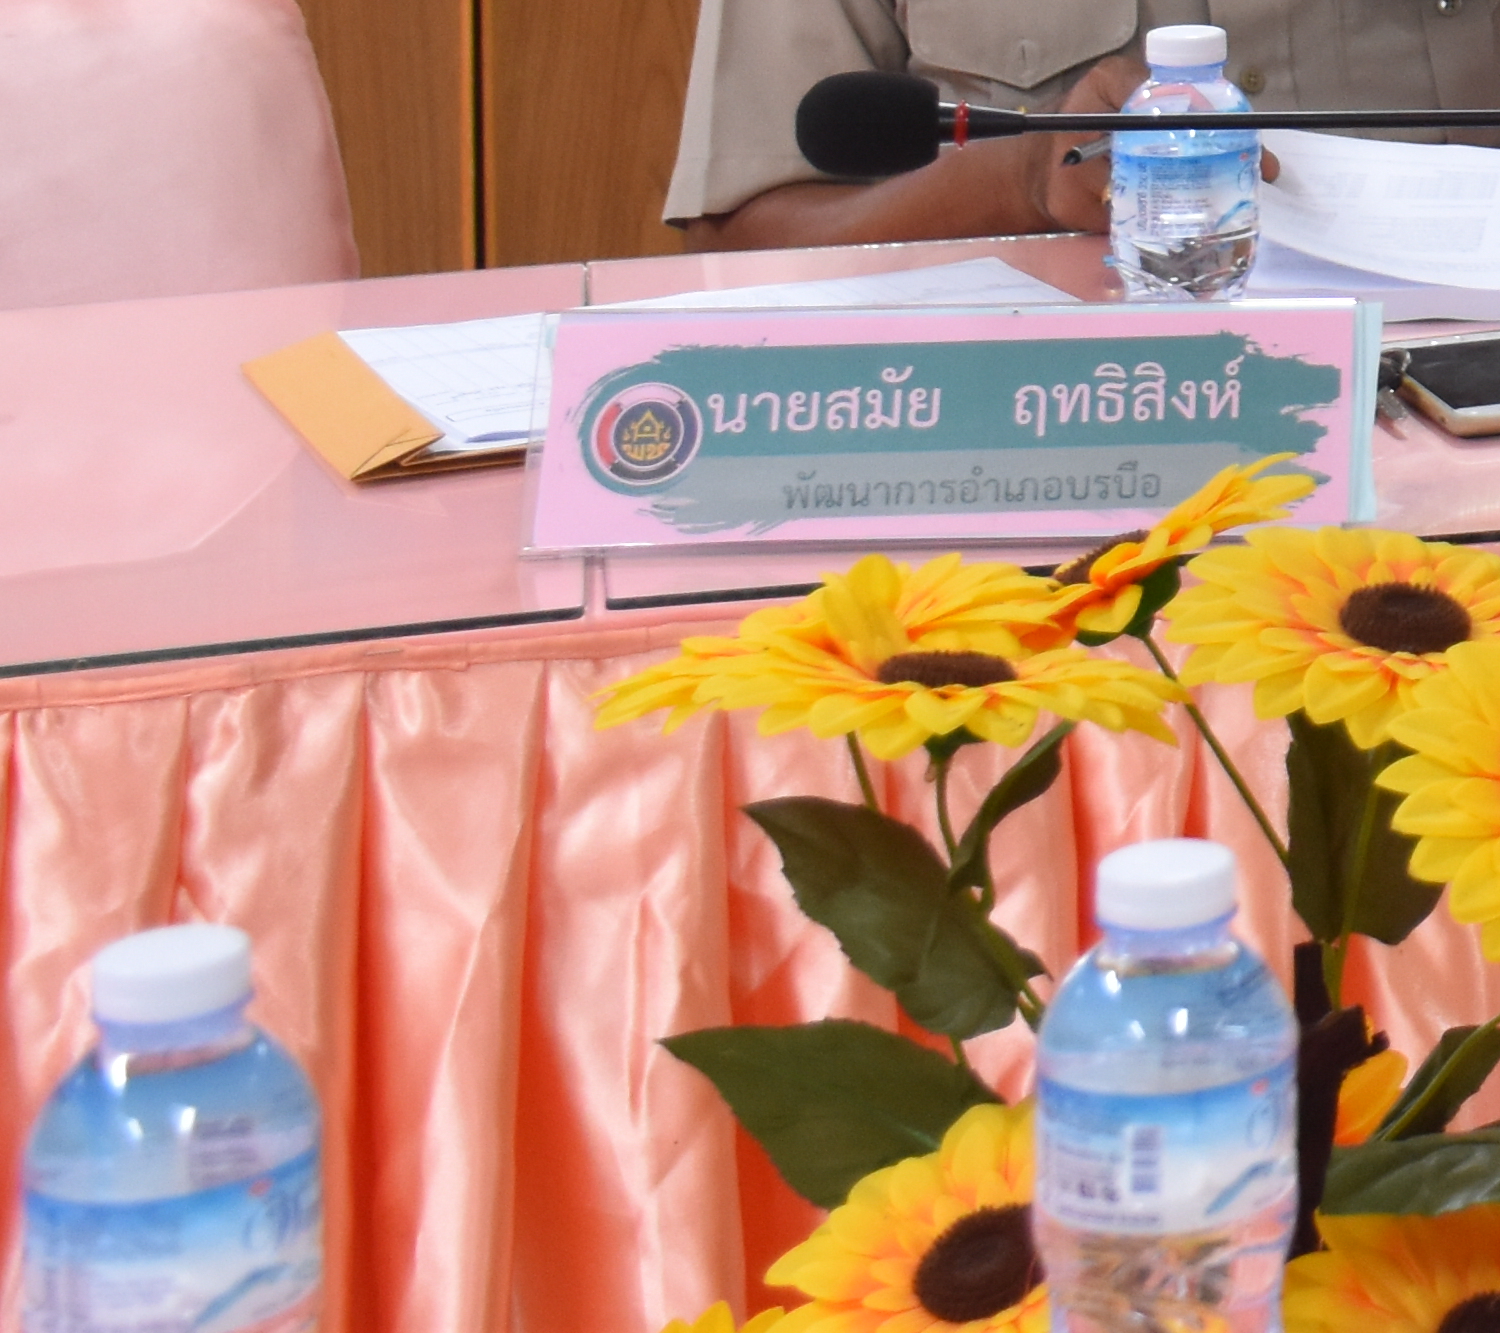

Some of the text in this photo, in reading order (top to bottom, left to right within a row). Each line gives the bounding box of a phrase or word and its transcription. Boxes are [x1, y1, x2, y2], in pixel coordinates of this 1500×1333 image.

[706, 355, 1244, 436] นายสมัย ฤทธิสิงห์
[781, 460, 1162, 511] พัฒนาการอำเภอบรบือ
